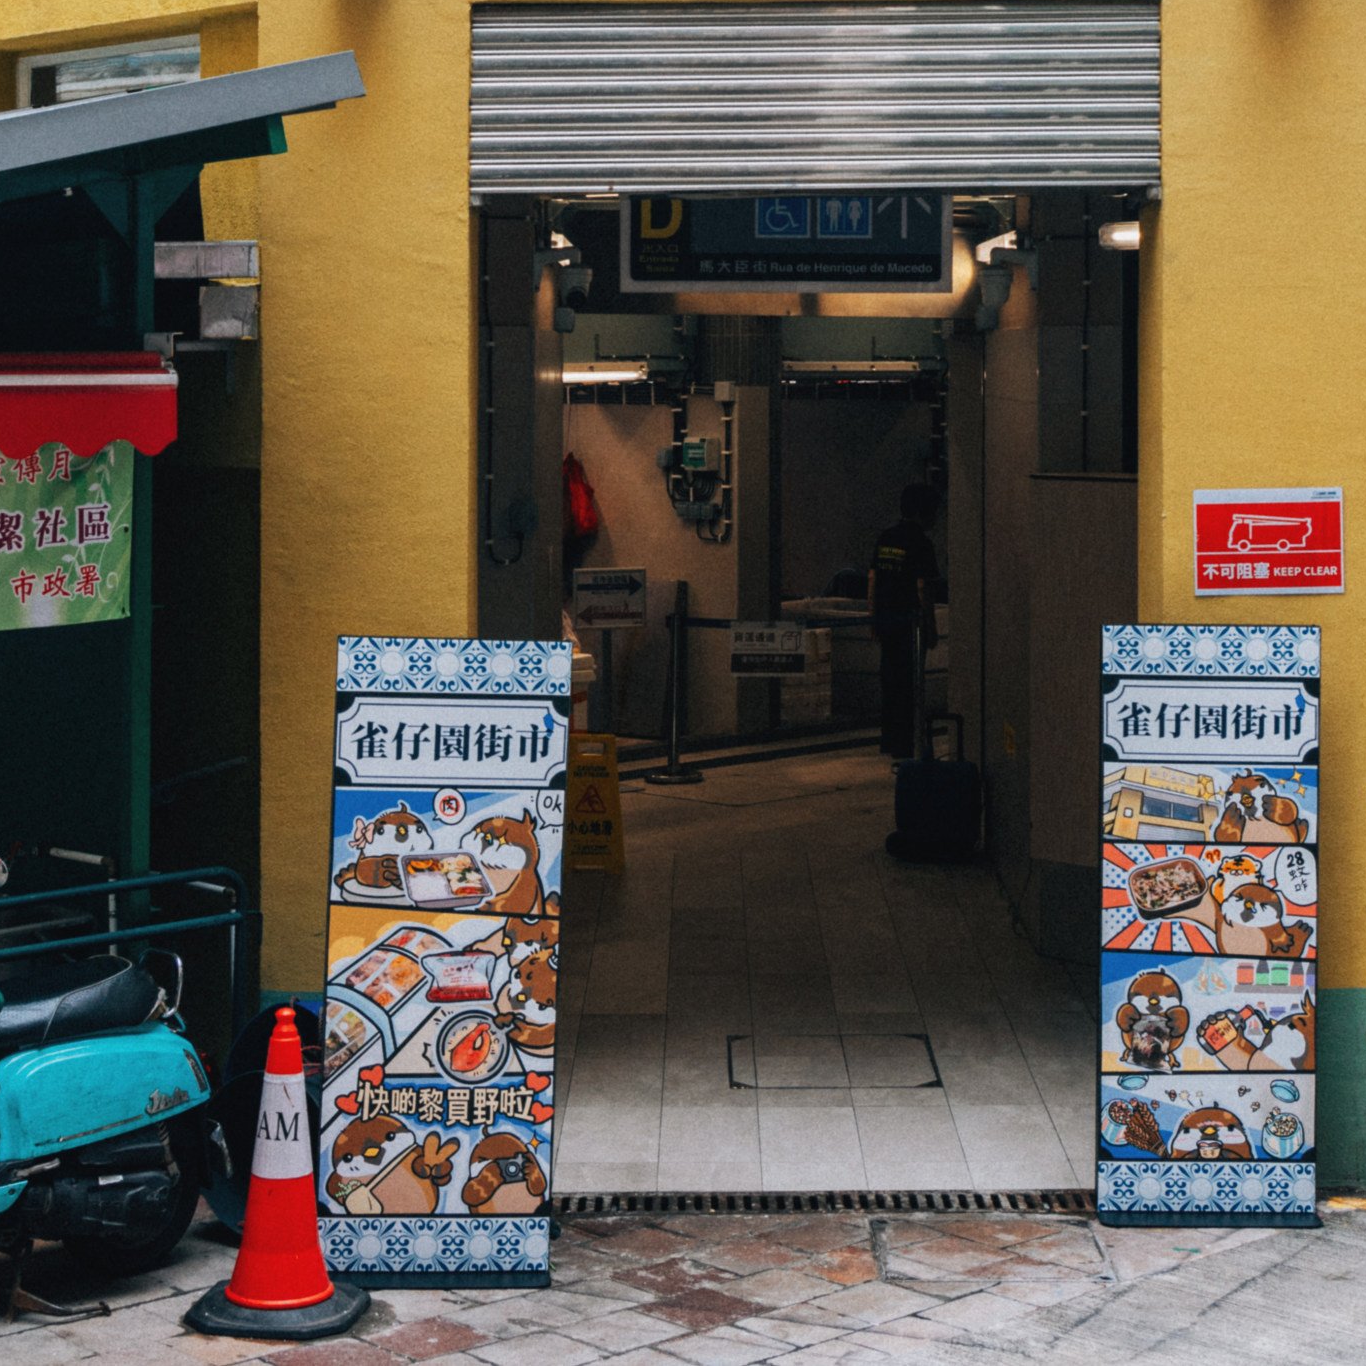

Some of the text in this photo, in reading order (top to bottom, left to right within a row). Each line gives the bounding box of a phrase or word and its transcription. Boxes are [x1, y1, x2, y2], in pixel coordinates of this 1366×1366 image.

[639, 198, 684, 239] D
[769, 262, 794, 273] Rua
[796, 263, 811, 273] de
[813, 262, 868, 276] Henrique
[870, 263, 885, 274] de
[887, 263, 933, 274] Macedo
[11, 563, 102, 605] 市政署
[1202, 562, 1338, 581] 不可阻塞 KEEP CLEAR
[1117, 701, 1304, 741] 雀仔園街市
[350, 720, 554, 763] 雀仔園街市
[1286, 851, 1305, 868] 28
[357, 1080, 538, 1127] 快啲黎買野啦
